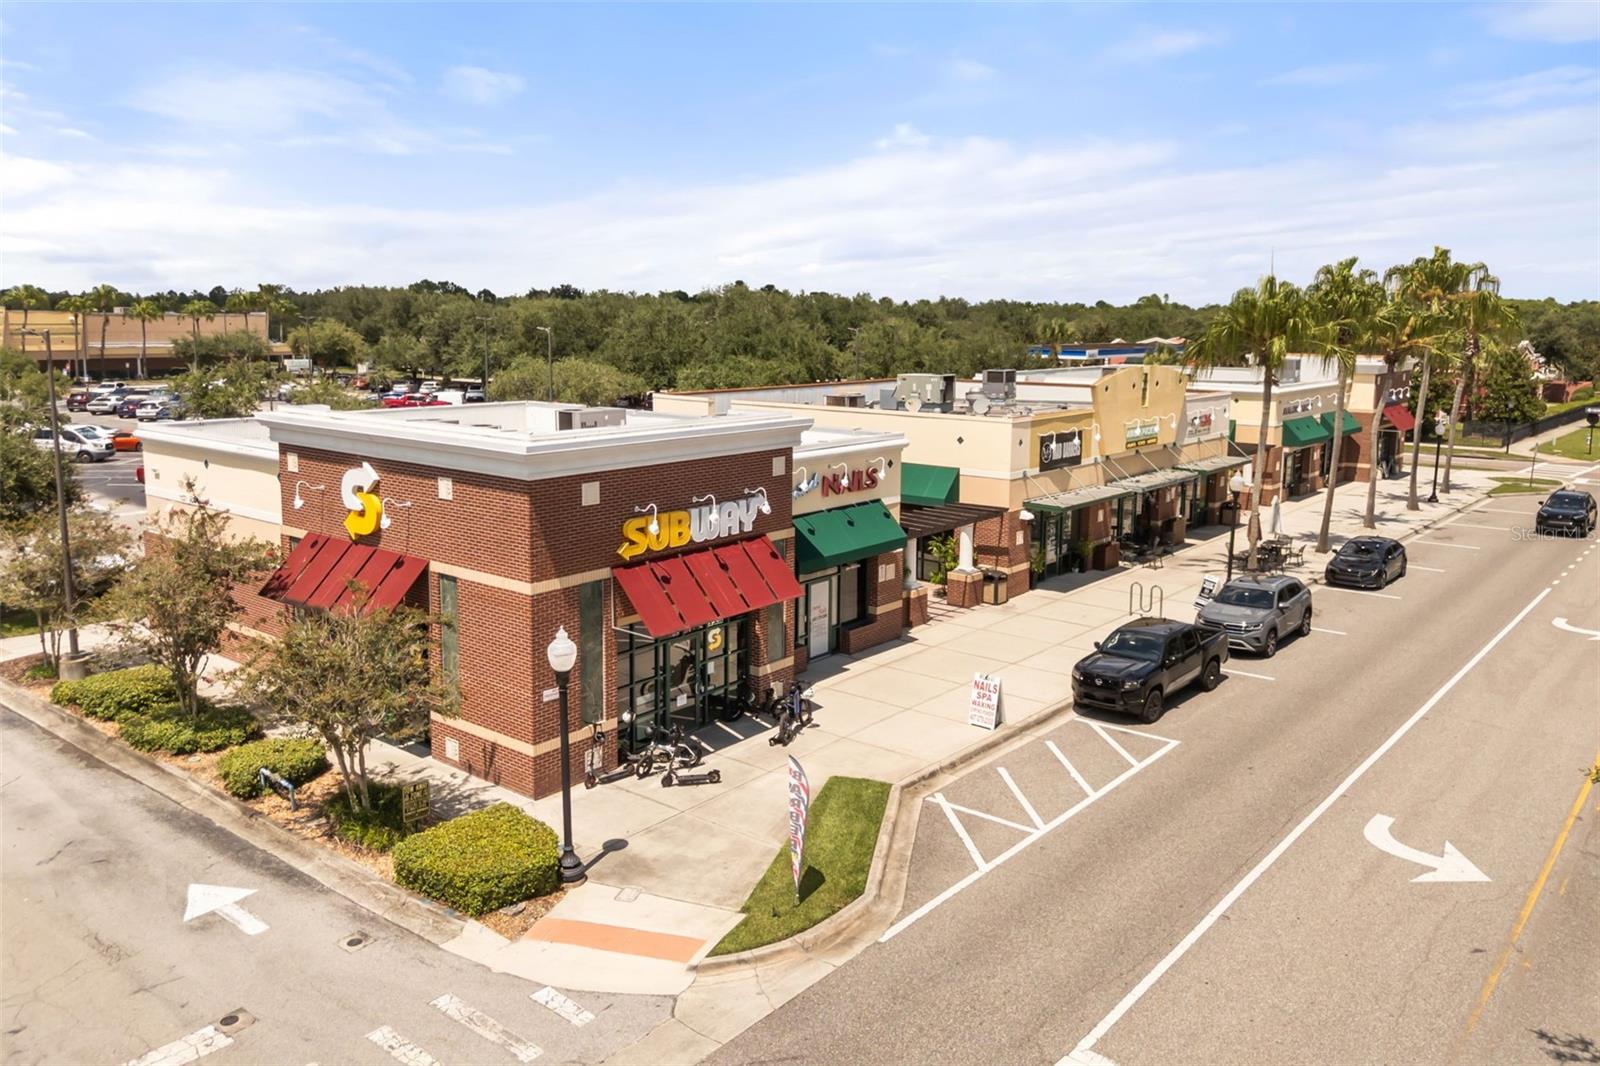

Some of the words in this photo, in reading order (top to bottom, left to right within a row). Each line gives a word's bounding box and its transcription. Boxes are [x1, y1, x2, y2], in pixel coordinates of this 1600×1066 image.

[821, 467, 879, 498] NAILS
[616, 494, 766, 561] SUBWAY
[974, 679, 998, 694] NAILS
[976, 691, 992, 702] SPA
[971, 700, 995, 711] WAXING
